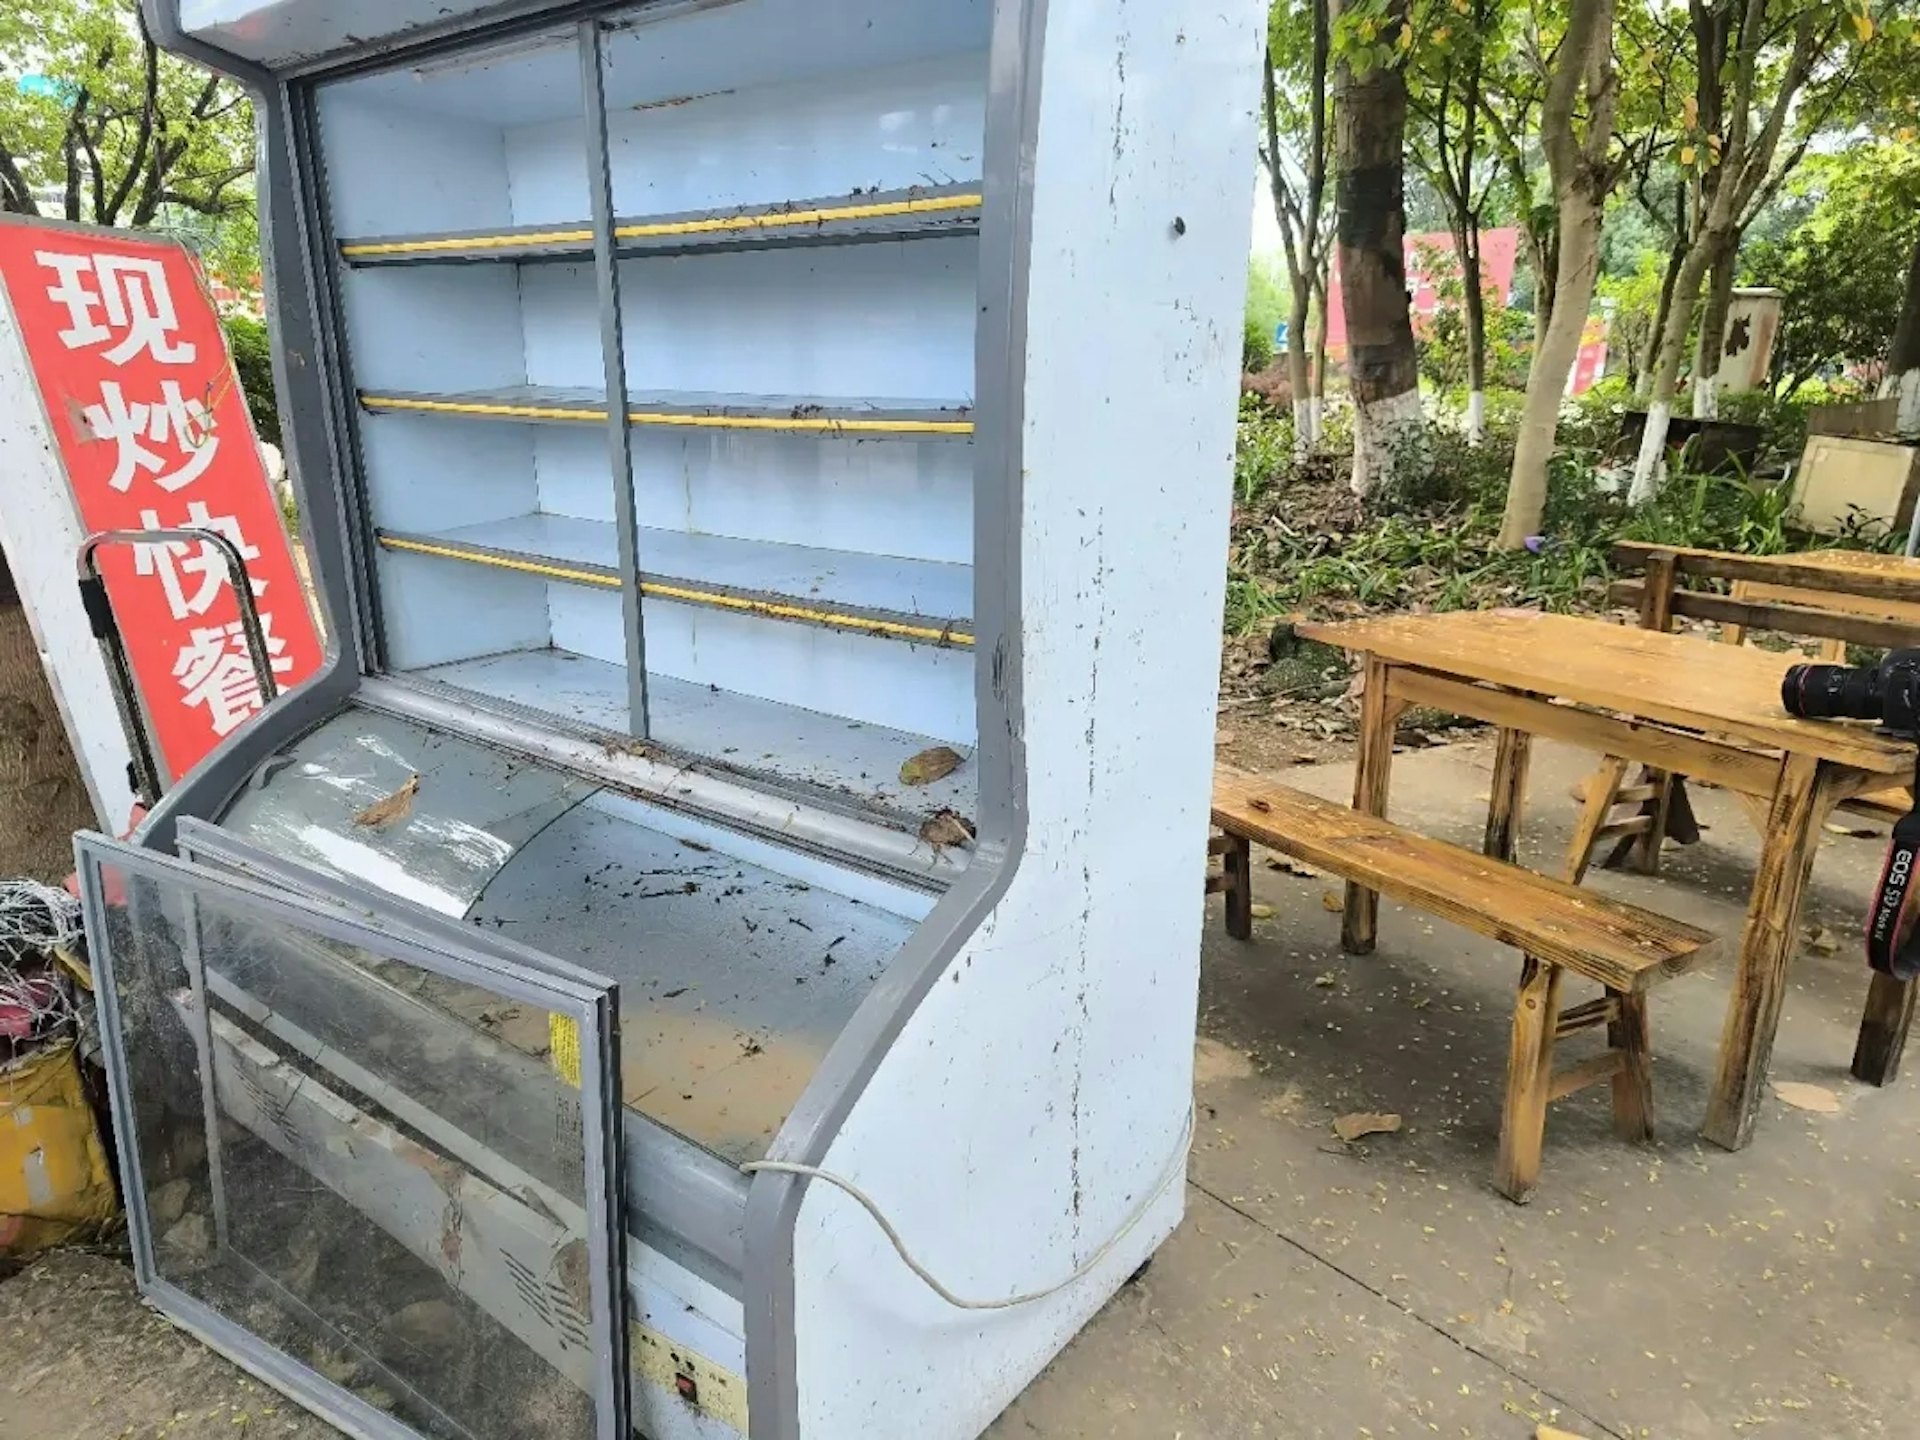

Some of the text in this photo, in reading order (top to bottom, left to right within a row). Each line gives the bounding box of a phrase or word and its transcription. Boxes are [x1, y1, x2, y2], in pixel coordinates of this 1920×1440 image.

[34, 249, 295, 738] 现炒快餐
[1889, 848, 1912, 886] EOS
